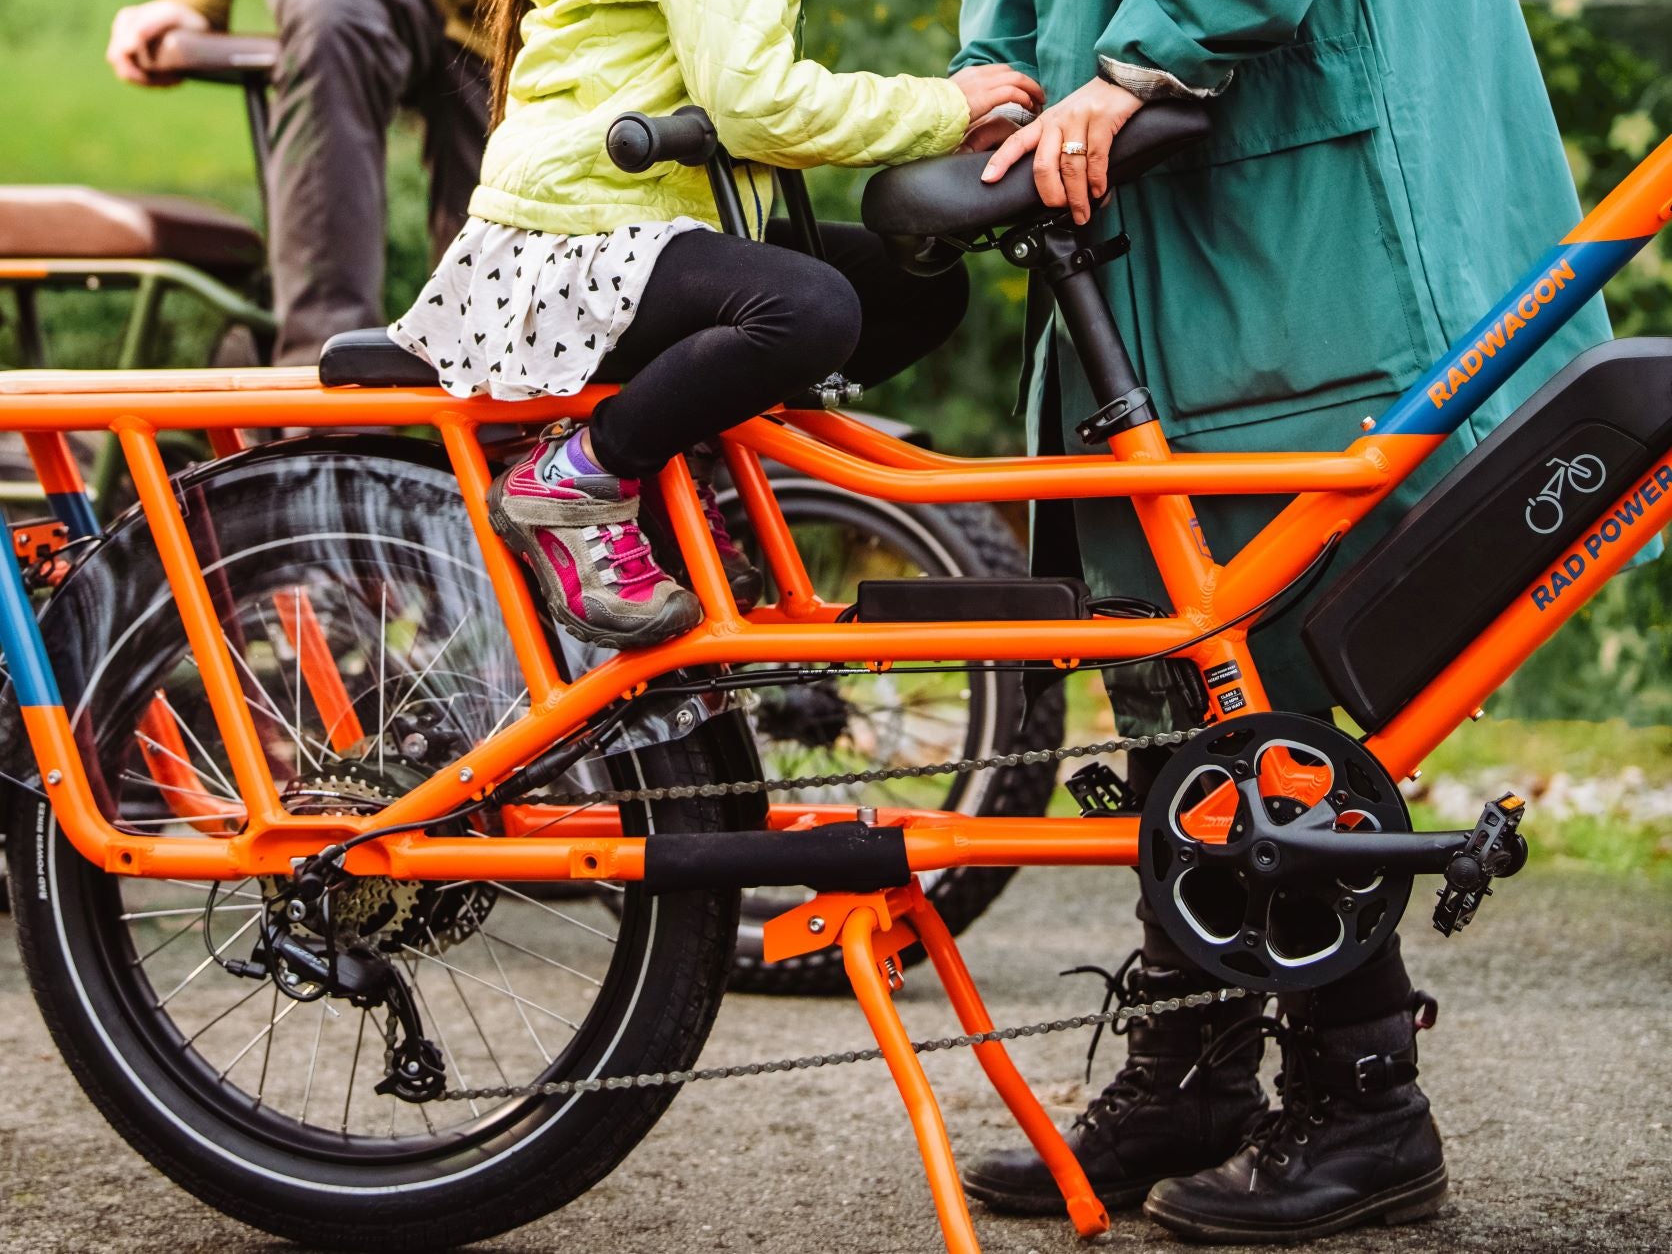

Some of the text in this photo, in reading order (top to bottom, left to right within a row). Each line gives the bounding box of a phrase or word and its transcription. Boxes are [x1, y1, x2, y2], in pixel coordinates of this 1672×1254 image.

[1426, 258, 1576, 409] RADWAGON
[1530, 464, 1672, 612] RAD POWER
[36, 802, 48, 900] RAD POWER BIKES
